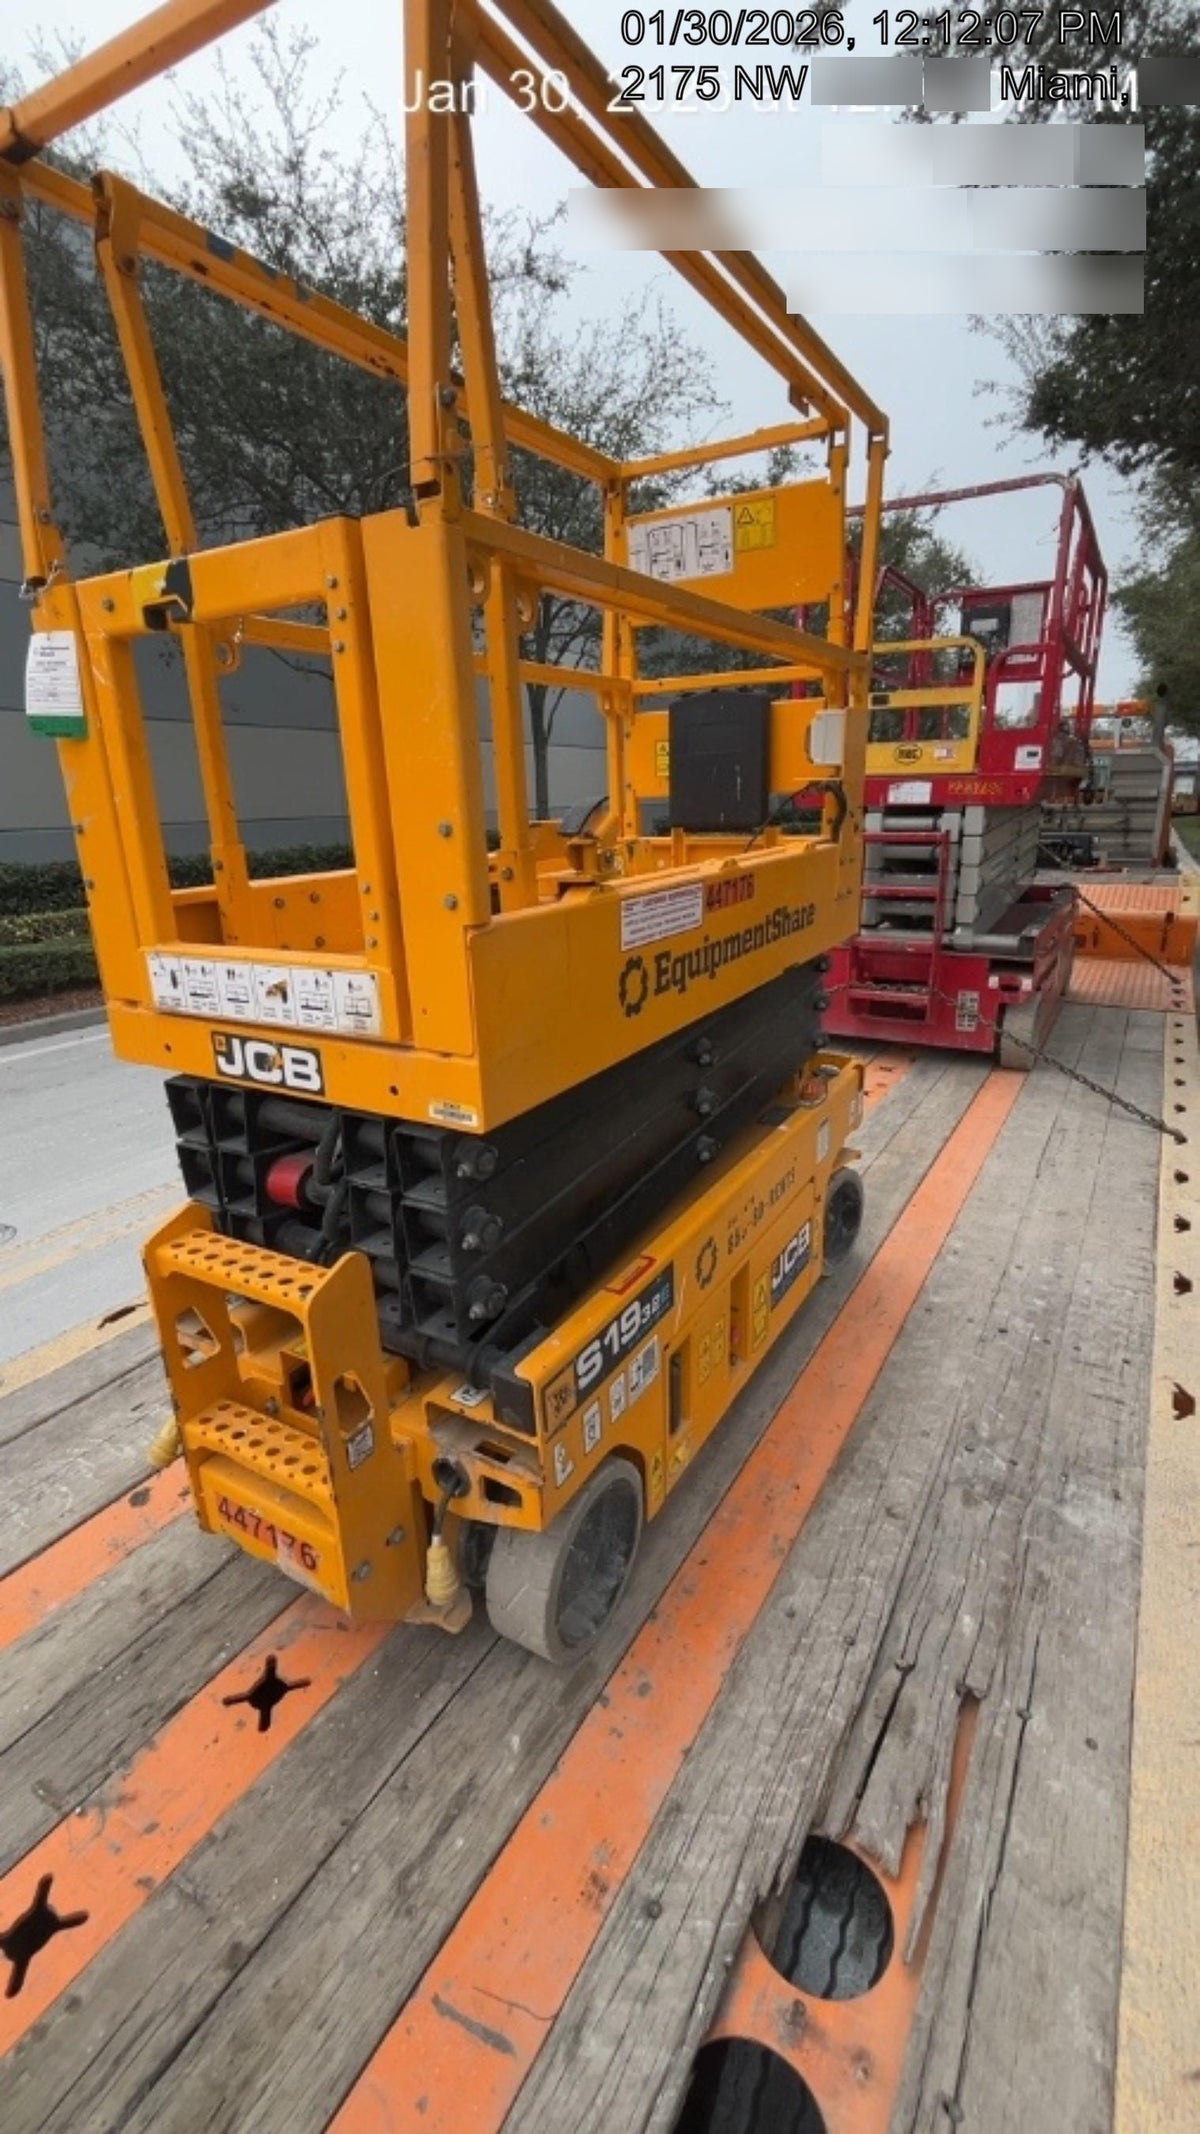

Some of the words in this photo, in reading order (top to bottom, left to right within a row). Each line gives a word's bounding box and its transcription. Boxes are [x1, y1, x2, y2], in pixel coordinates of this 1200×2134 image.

[705, 873, 755, 911] 447176
[654, 902, 817, 996] EquipmentShare
[217, 1037, 321, 1092] JCB
[772, 1221, 810, 1290] JCB
[218, 1496, 318, 1571] 447176
